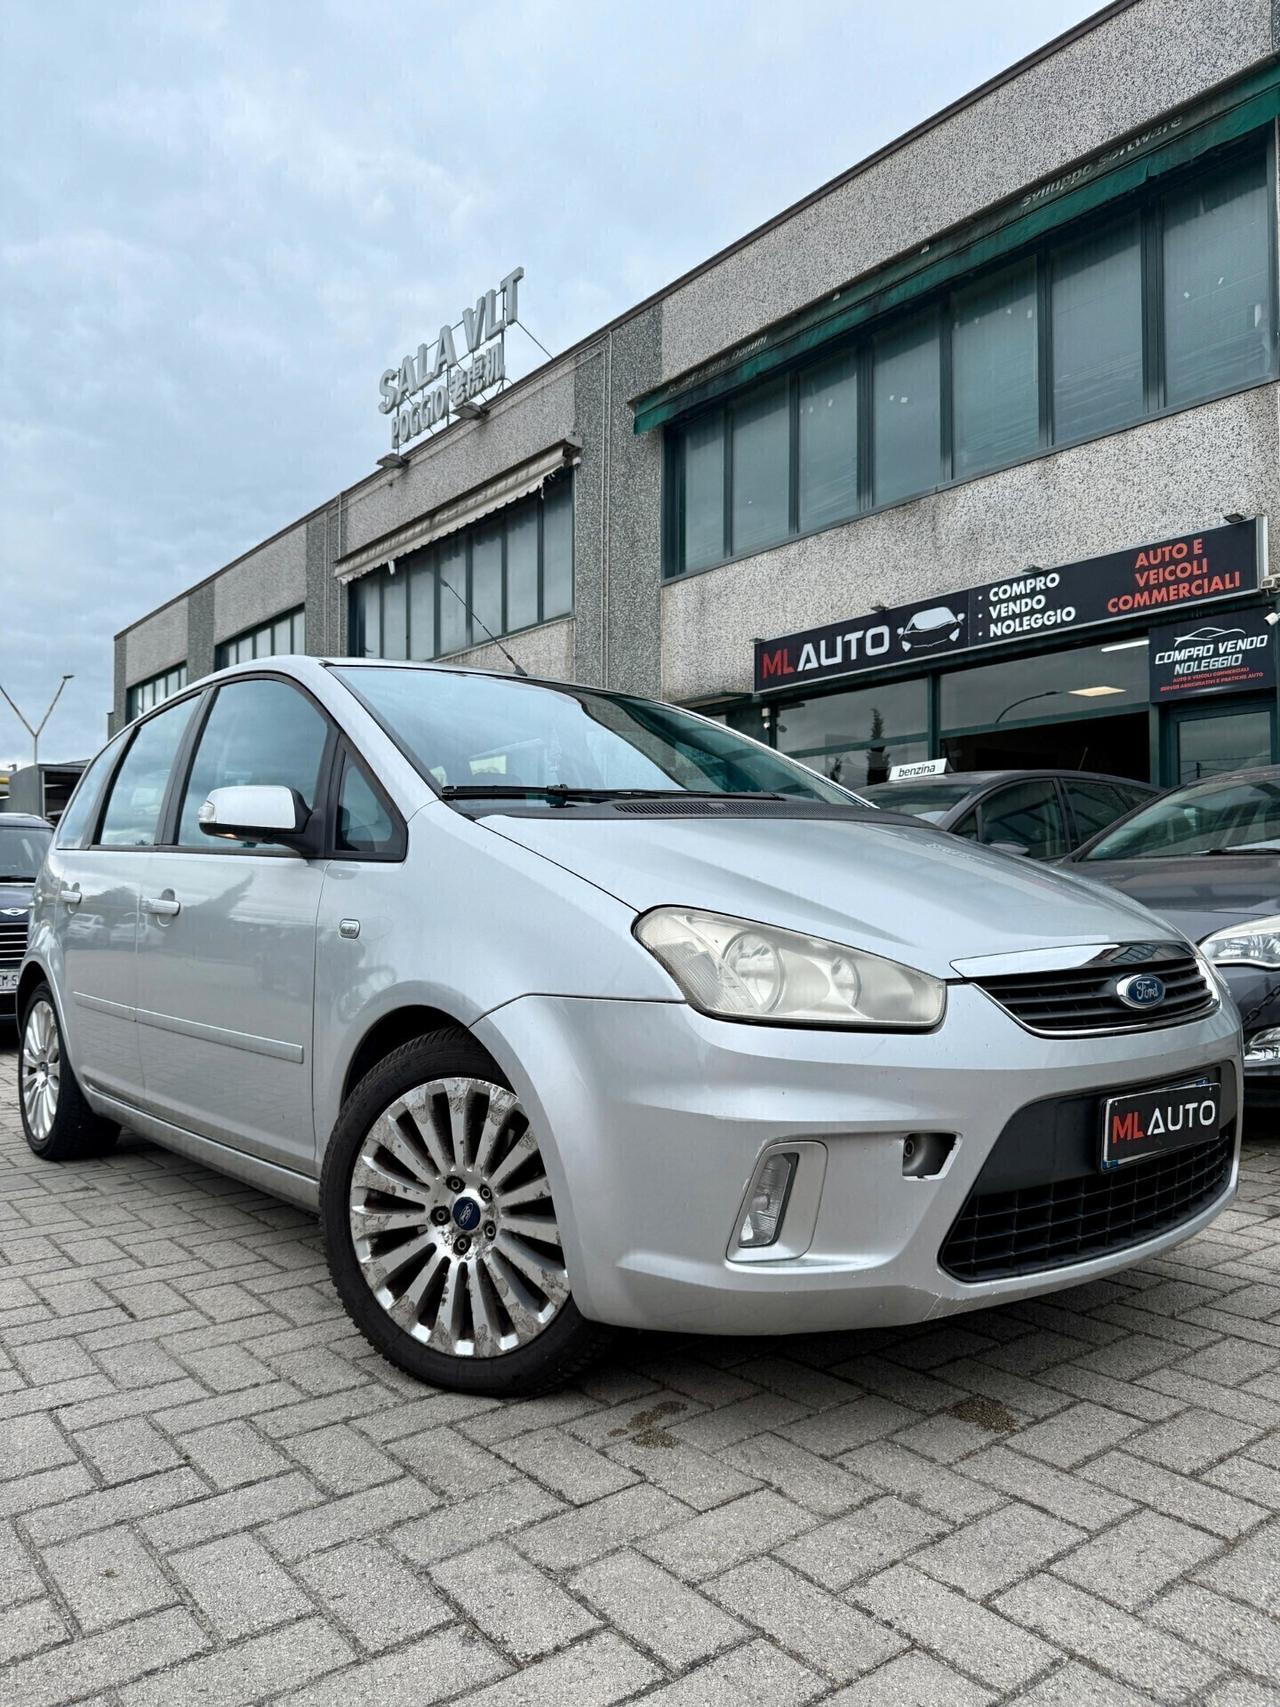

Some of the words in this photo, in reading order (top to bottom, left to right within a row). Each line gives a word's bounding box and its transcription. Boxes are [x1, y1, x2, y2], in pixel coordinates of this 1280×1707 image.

[378, 325, 458, 414] SALA
[462, 266, 524, 353] VLT
[391, 385, 449, 449] POGGIO
[1135, 542, 1188, 569] AUTO
[1193, 538, 1204, 555] E
[989, 573, 1060, 602] COMPRO
[1135, 557, 1208, 587] VEICOLI
[989, 595, 1046, 619] VENDO
[1107, 571, 1241, 613] COMMERCIALI
[989, 606, 1076, 638] NOLEGGIO
[761, 648, 795, 679] ML
[797, 625, 890, 672] AUTO
[1155, 644, 1214, 665] COMPRO
[1218, 634, 1268, 654] VENDO
[1174, 653, 1243, 675] NOLEGGIO
[898, 763, 936, 777] benzina
[1136, 980, 1160, 1000] Ford
[1112, 1111, 1145, 1144] ML
[1147, 1099, 1216, 1136] AUTO
